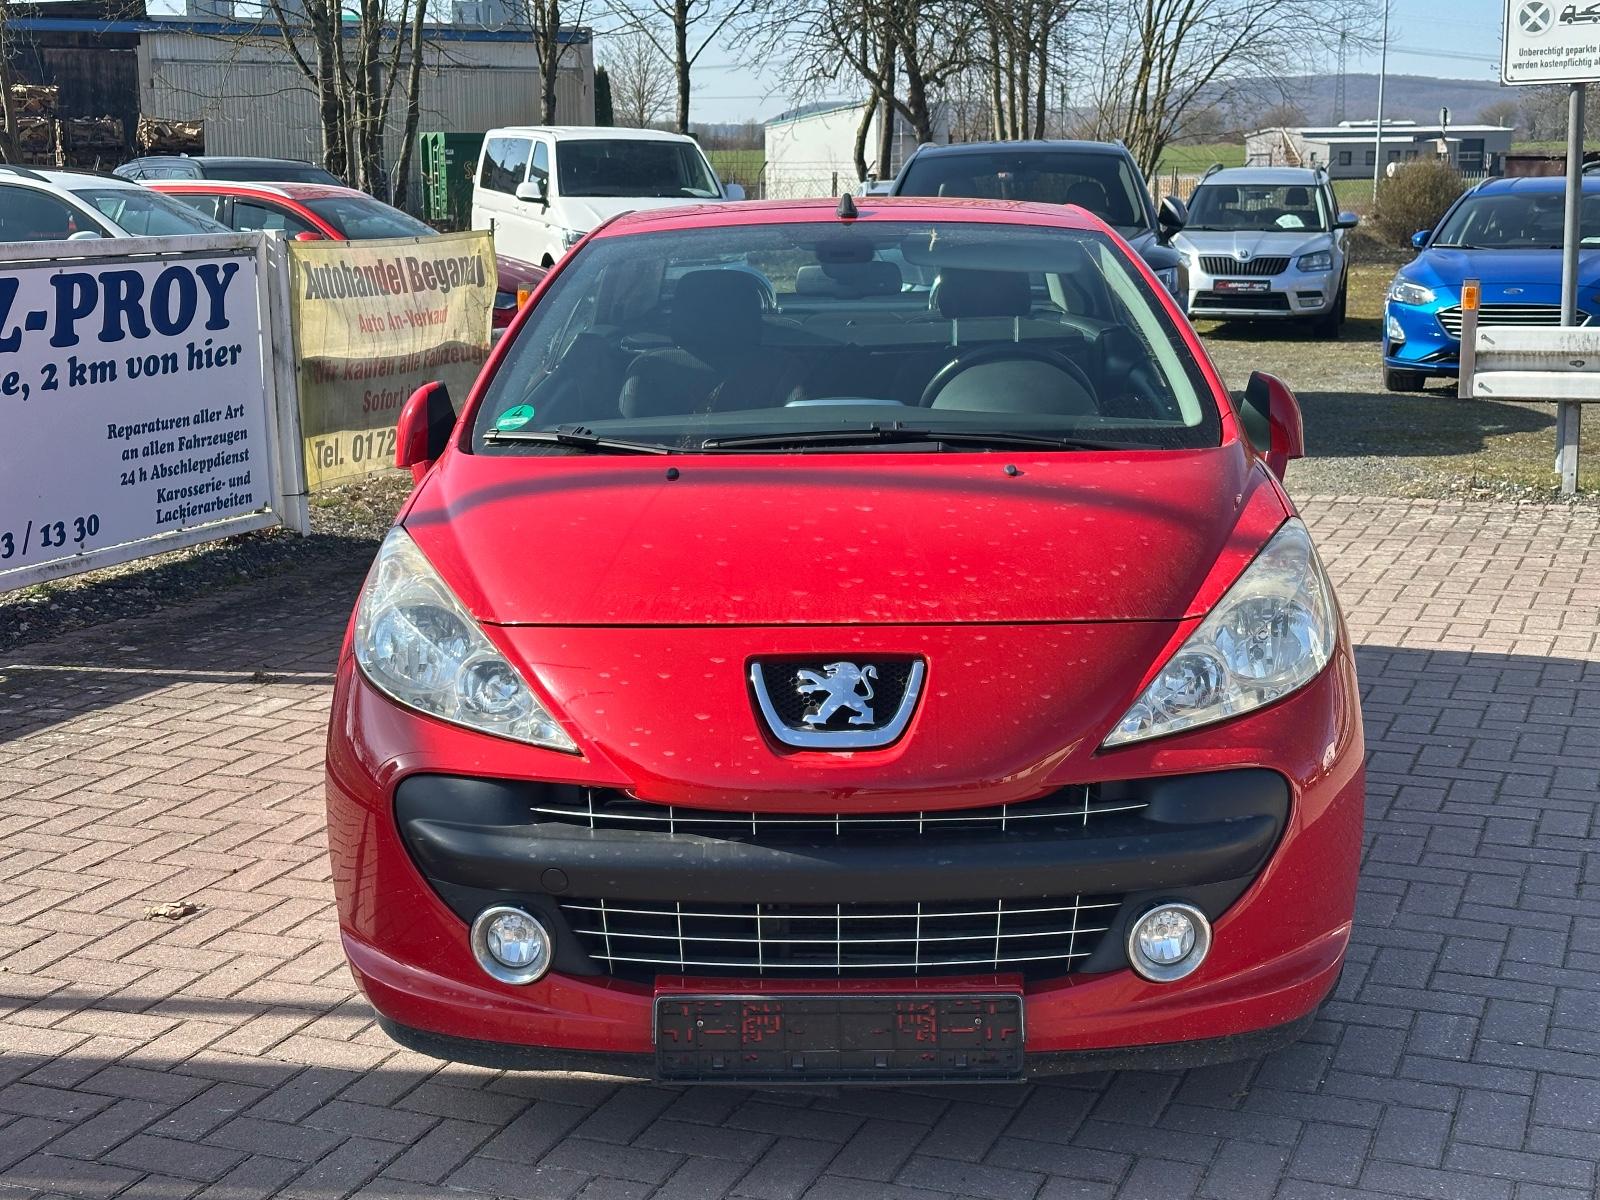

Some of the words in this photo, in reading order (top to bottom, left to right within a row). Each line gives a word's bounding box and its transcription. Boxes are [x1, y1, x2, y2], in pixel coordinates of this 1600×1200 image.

[1512, 60, 1538, 69] werden
[1540, 57, 1592, 68] kostenpflichtig
[1518, 46, 1563, 57] Unberechtigt
[1565, 44, 1597, 56] geparkte
[303, 257, 408, 300] Autohandel
[358, 312, 384, 333] Auto
[387, 305, 448, 331] An-Verkauf
[0, 371, 30, 401] e,
[41, 362, 59, 391] 2
[68, 355, 118, 388] km
[125, 353, 179, 380] von
[186, 338, 242, 369] hier
[399, 352, 420, 374] alle
[363, 385, 404, 413] Sofort
[512, 405, 525, 417] 4
[107, 414, 190, 440] Reparaturen
[193, 407, 222, 425] aller
[225, 403, 245, 420] Art
[121, 446, 139, 461] an
[142, 440, 176, 457] allen
[178, 428, 248, 451] Fahrzeugen
[315, 436, 344, 469] Tel.
[352, 428, 397, 463] 0172
[120, 471, 136, 487] 24
[139, 467, 148, 482] h
[151, 448, 250, 481] Abschleppdienst
[156, 480, 226, 504] Karosserie-
[228, 471, 252, 488] und
[156, 491, 253, 525] Lackierarbeiten
[40, 521, 67, 547] 13
[73, 514, 100, 542] 30
